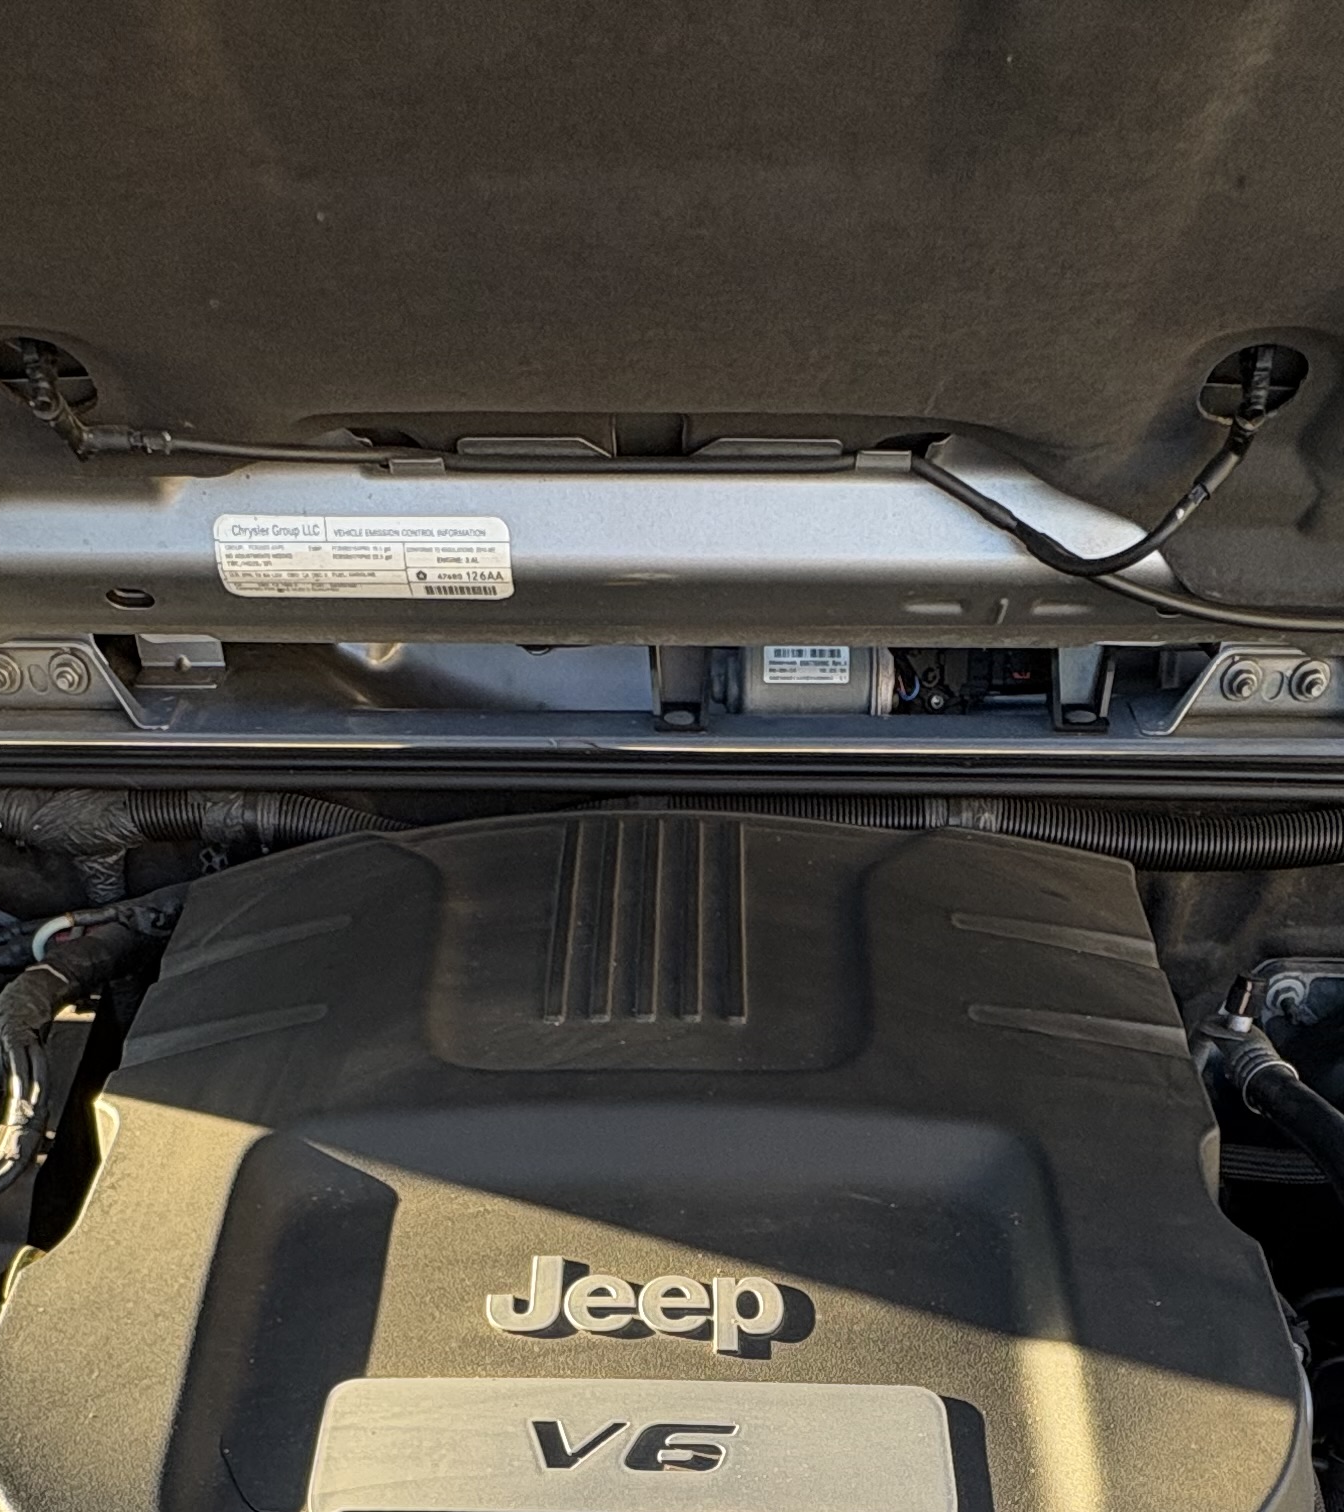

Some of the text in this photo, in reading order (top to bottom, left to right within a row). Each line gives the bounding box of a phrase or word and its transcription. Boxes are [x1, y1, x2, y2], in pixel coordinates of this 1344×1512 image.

[231, 523, 321, 540] Chrysler Group LLC
[333, 527, 487, 538] VEHICLE EMISSION CONTROL INFORMATION
[485, 1254, 785, 1354] Jeep
[528, 1419, 741, 1473] V6
